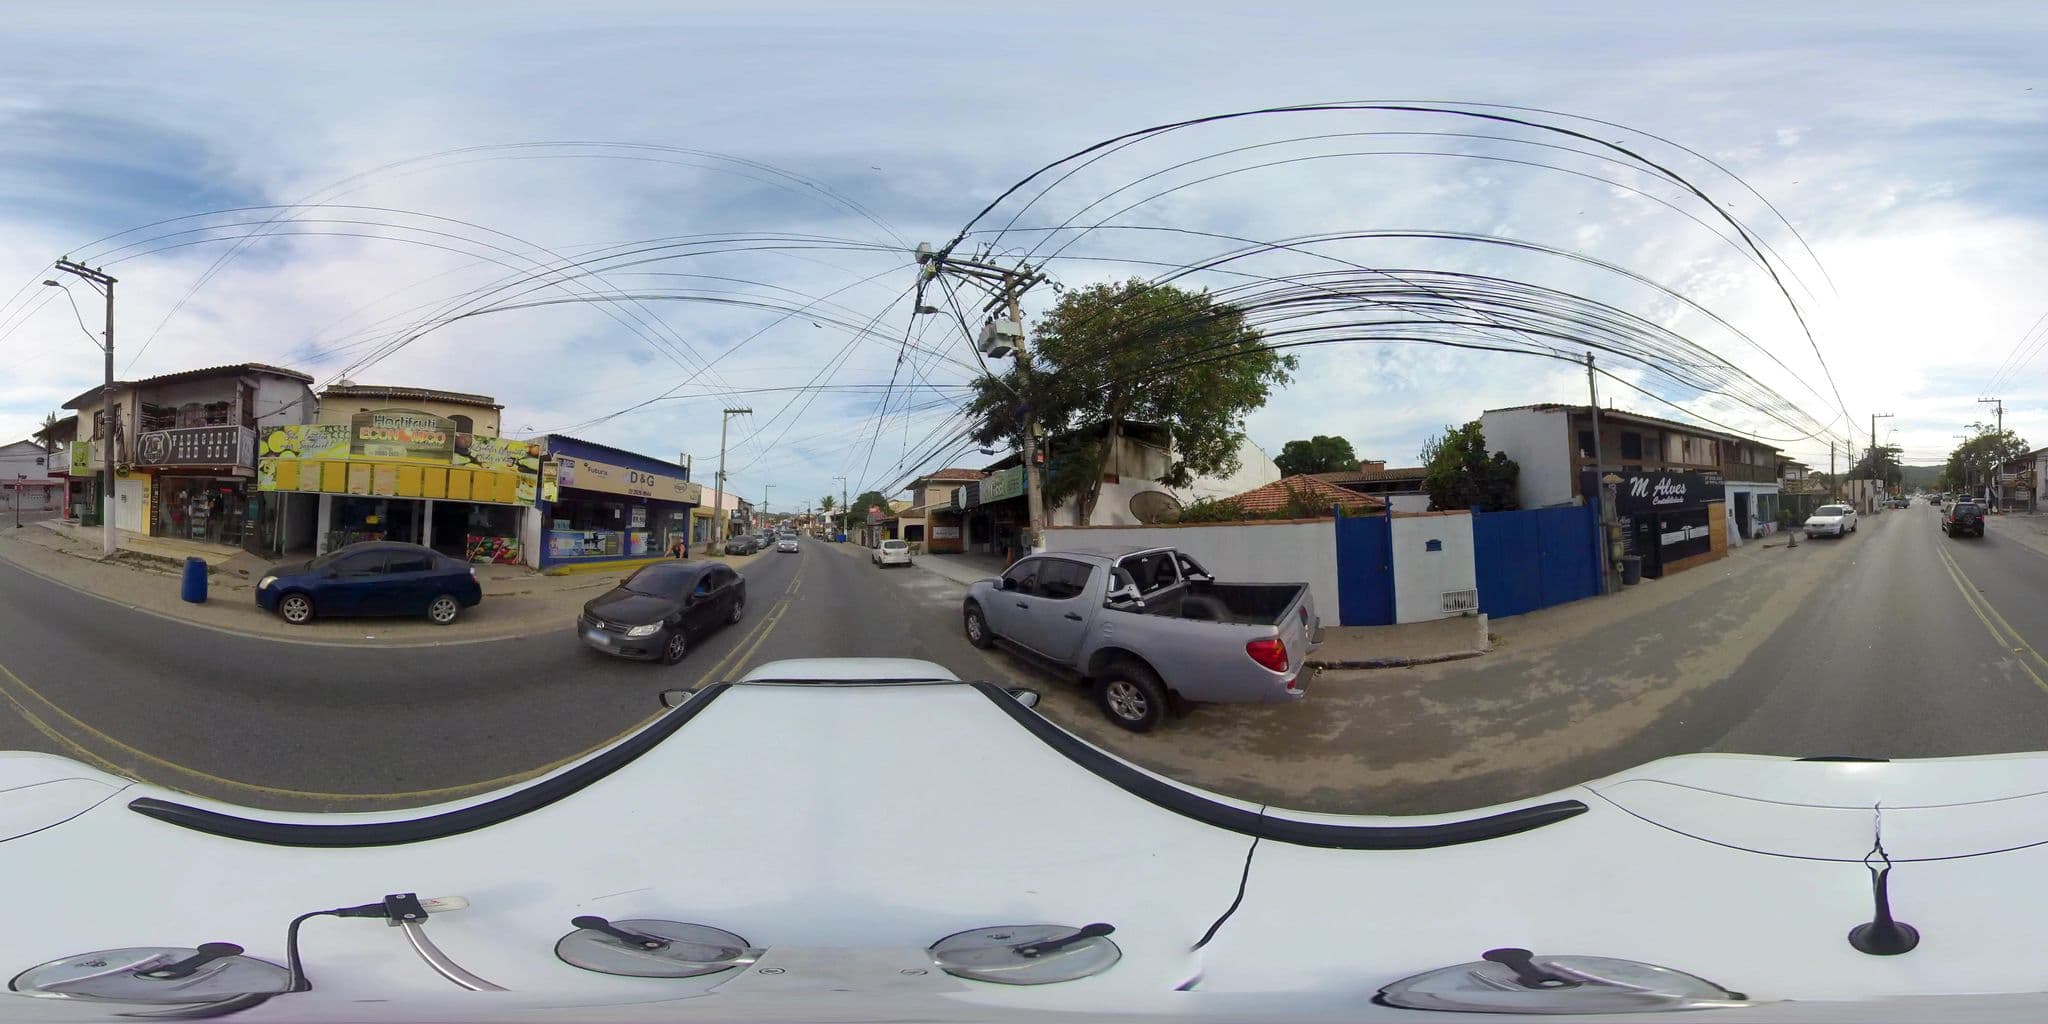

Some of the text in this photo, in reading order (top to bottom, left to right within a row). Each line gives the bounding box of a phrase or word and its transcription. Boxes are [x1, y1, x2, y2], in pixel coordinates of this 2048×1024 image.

[374, 415, 437, 432] Hortifruti
[1630, 476, 1650, 498] M
[1652, 476, 1687, 497] Alves
